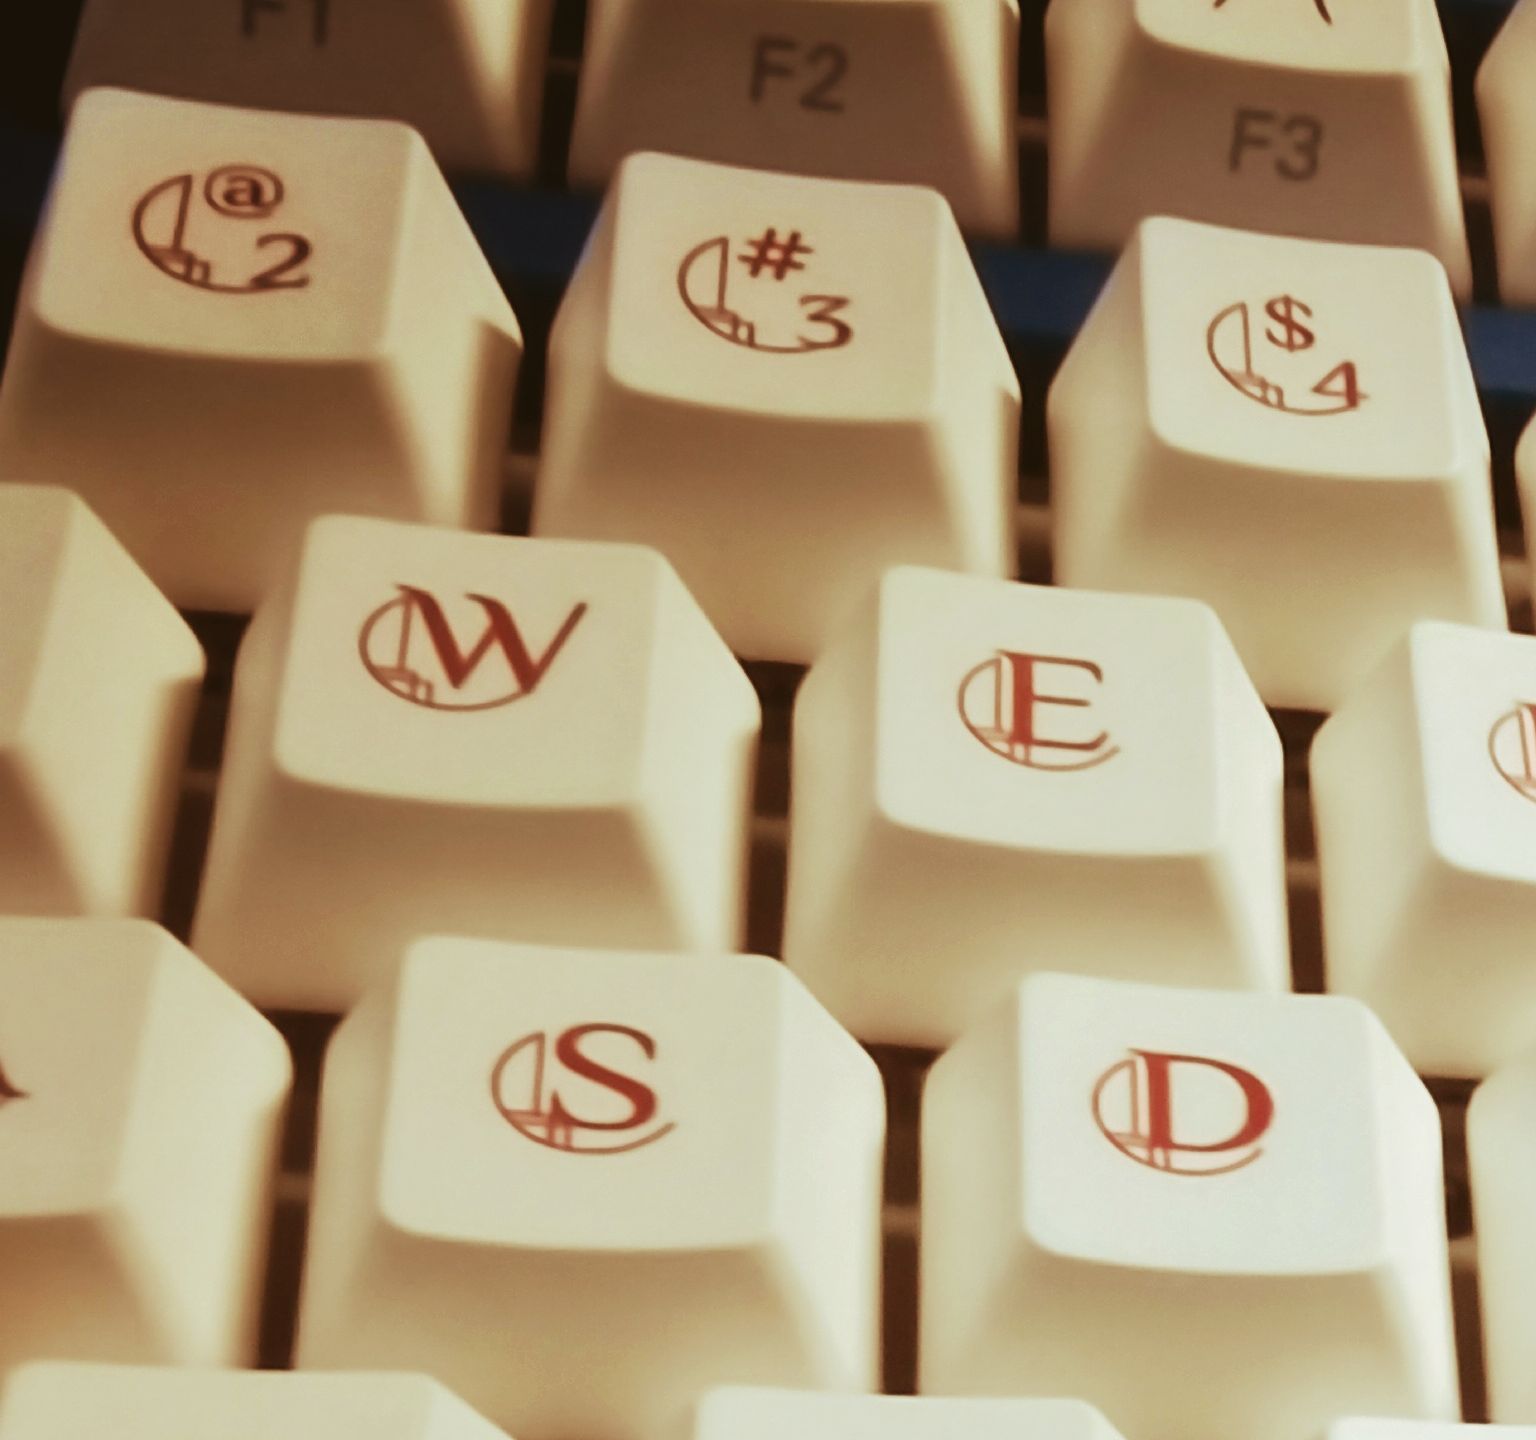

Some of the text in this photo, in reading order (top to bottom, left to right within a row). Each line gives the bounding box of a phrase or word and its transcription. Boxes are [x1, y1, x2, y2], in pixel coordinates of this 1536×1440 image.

[748, 35, 850, 114] F2
[1227, 107, 1324, 183] F3
[203, 162, 285, 220] @
[248, 230, 313, 291] 2
[737, 226, 815, 281] #
[795, 294, 855, 351] 3
[1263, 294, 1316, 353] $
[1311, 360, 1371, 410] 4
[393, 582, 589, 696] W
[993, 647, 1110, 754] E
[551, 1021, 662, 1132] S
[1126, 1046, 1276, 1158] D
